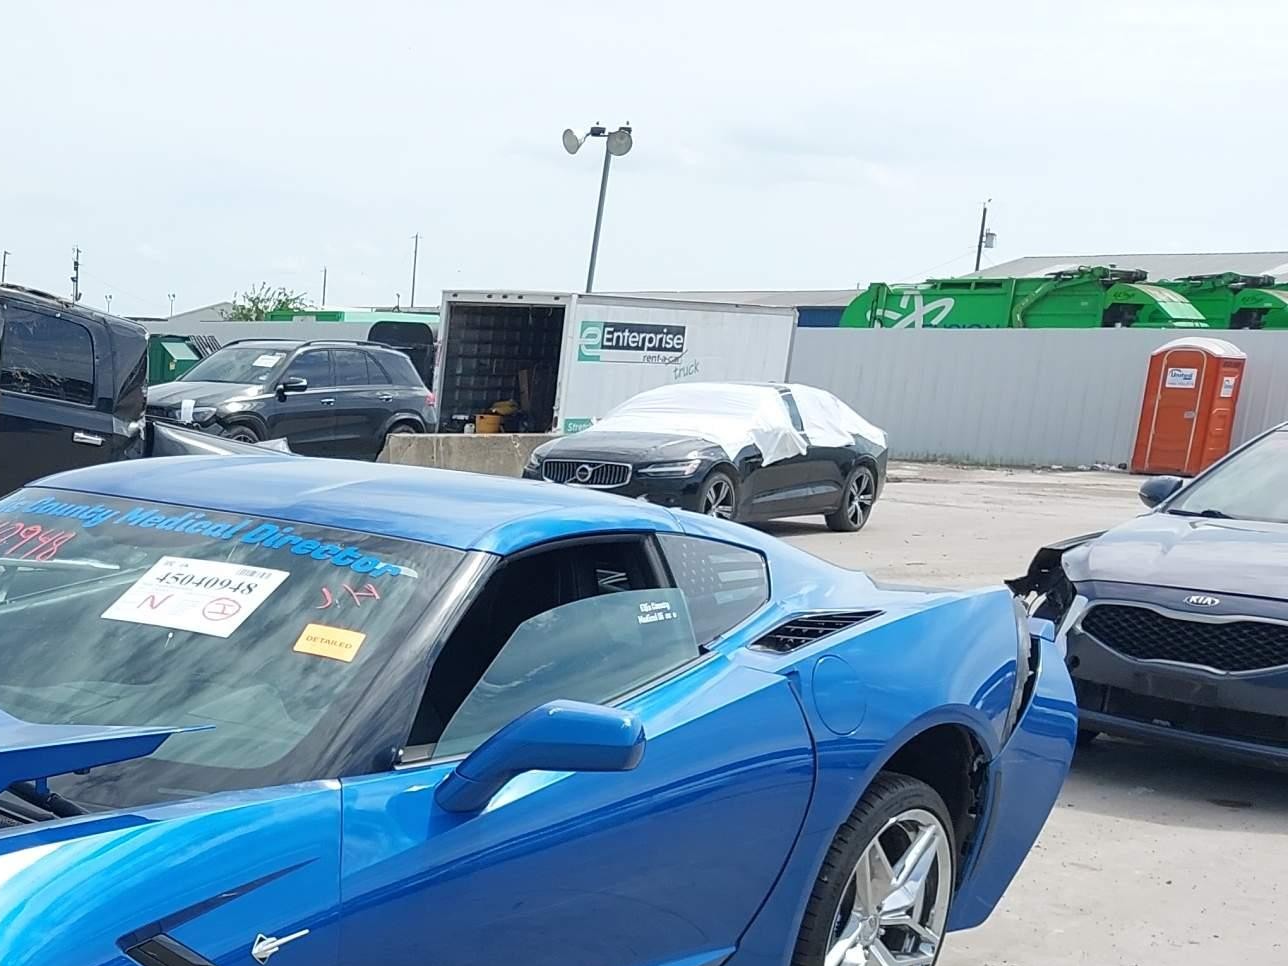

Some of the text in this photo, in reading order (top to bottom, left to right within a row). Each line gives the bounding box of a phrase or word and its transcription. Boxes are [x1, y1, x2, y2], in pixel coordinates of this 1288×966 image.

[602, 327, 684, 352] Enterprise
[673, 360, 700, 380] truck
[27, 496, 116, 528] County
[117, 507, 252, 539] Medical
[241, 523, 404, 578] Director
[155, 571, 258, 596] 45040948
[136, 594, 174, 610] N
[305, 634, 353, 650] DETAILED
